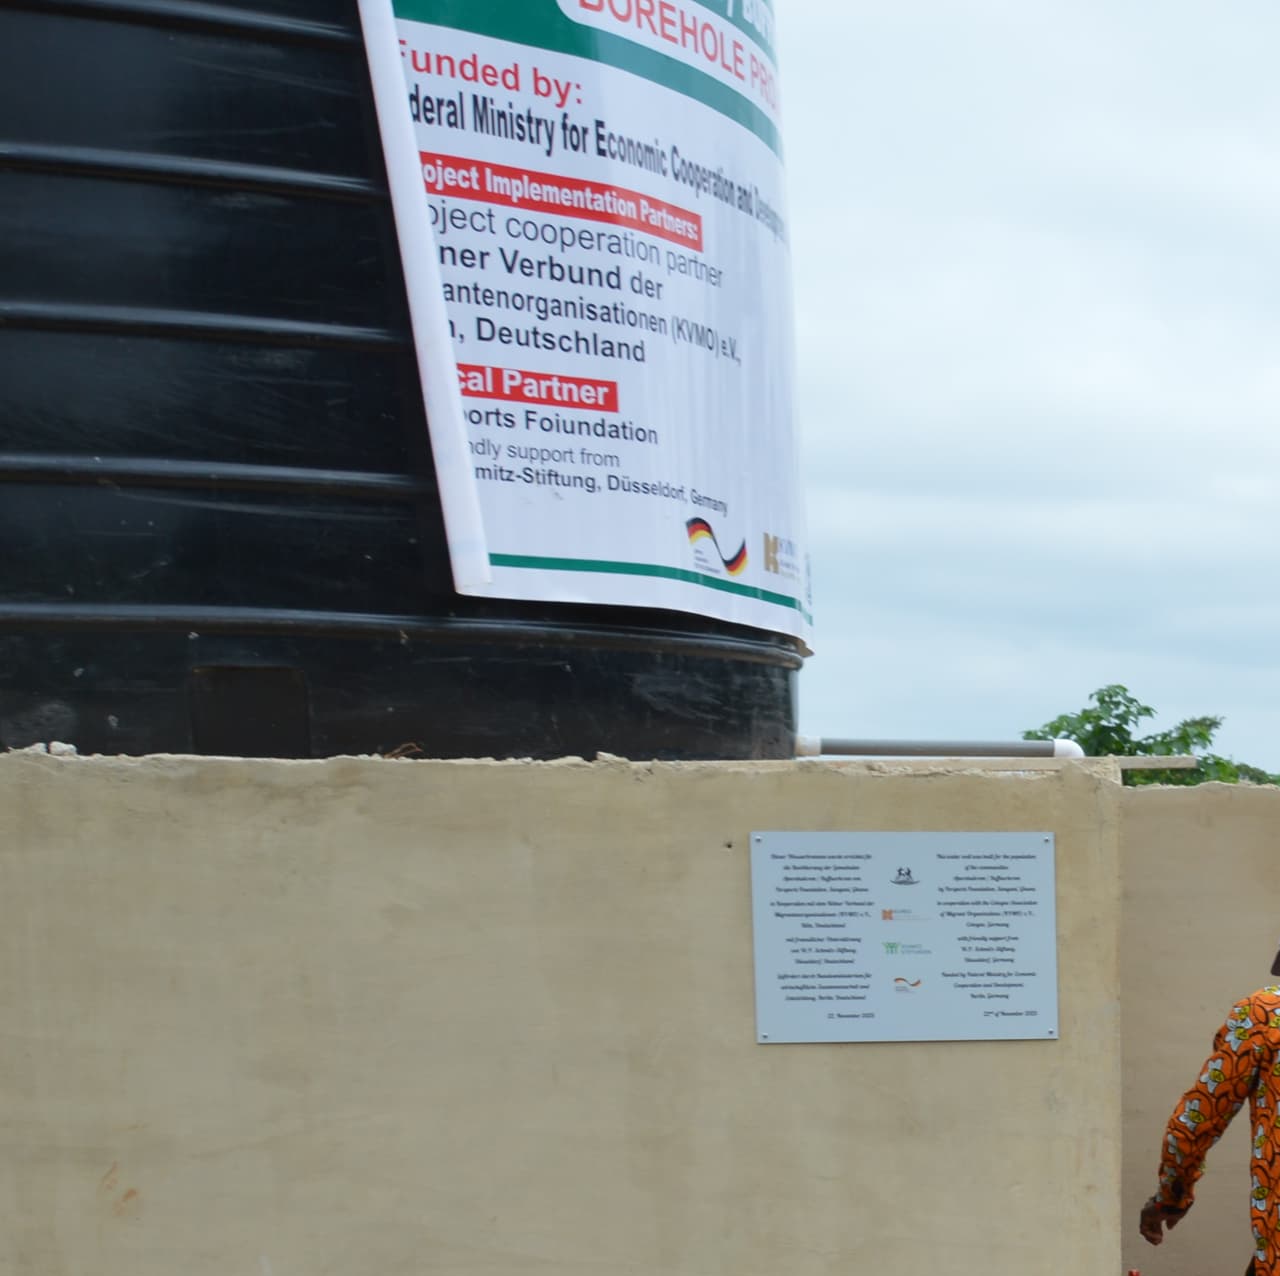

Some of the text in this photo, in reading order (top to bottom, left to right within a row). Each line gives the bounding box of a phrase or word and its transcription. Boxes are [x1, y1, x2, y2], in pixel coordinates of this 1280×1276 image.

[532, 67, 582, 108] by:
[472, 94, 555, 157] Ministry
[562, 112, 589, 154] for
[595, 119, 668, 177] Economic
[485, 166, 638, 220] Implementation
[639, 199, 699, 241] Partners:
[499, 247, 622, 291] Verbund
[630, 270, 664, 301] der
[506, 216, 660, 266] cooperation
[666, 250, 723, 287] partner
[443, 282, 668, 336] antenorganisationen
[476, 317, 646, 363] Deutschland
[502, 368, 610, 406] Partner
[464, 407, 659, 445] orts Foiundation
[507, 443, 575, 465] support
[580, 447, 621, 468] from
[475, 464, 602, 494] mitz-Stiftung,
